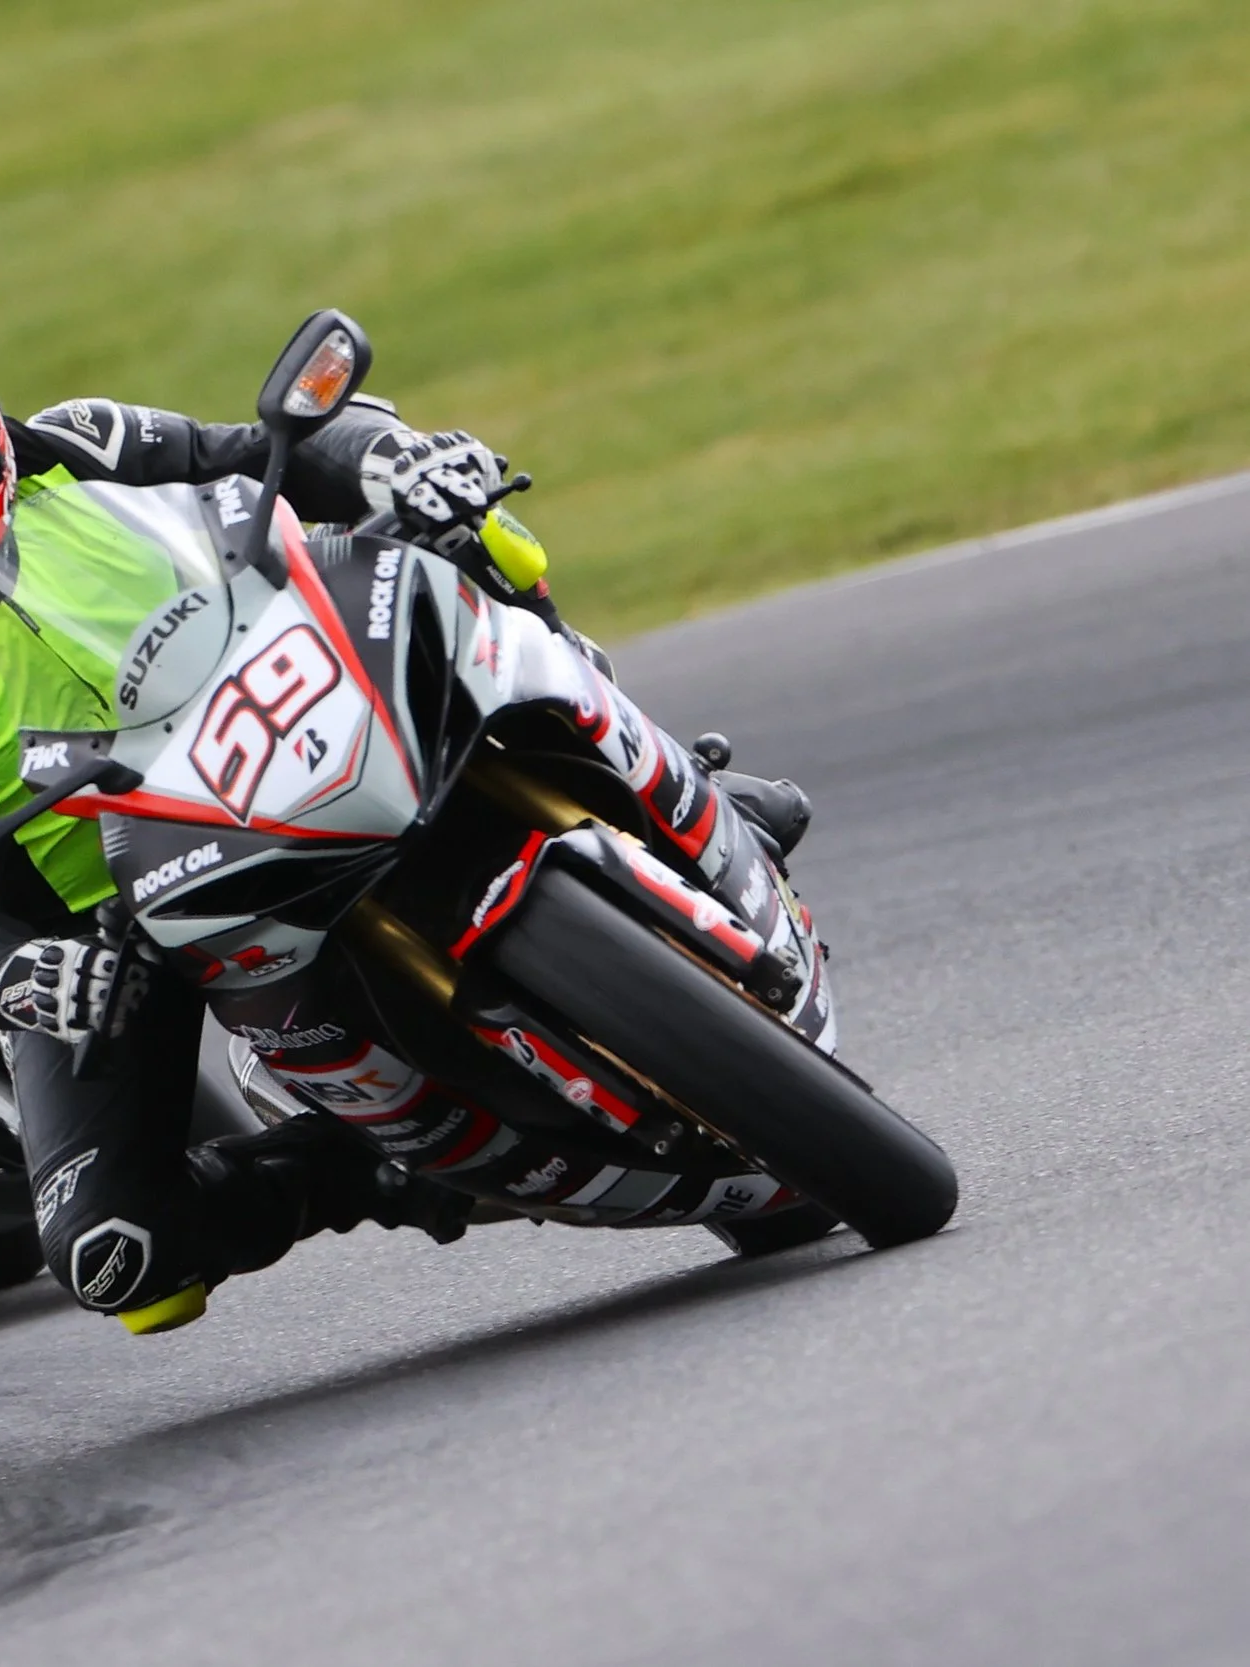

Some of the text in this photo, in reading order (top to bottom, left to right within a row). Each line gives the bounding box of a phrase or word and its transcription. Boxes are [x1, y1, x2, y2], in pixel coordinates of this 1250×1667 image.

[368, 547, 402, 640] ROCK OIL
[119, 591, 210, 711] SUZUKI
[188, 623, 342, 824] 59
[133, 841, 223, 902] ROCK OIL
[81, 1236, 129, 1302] RST
